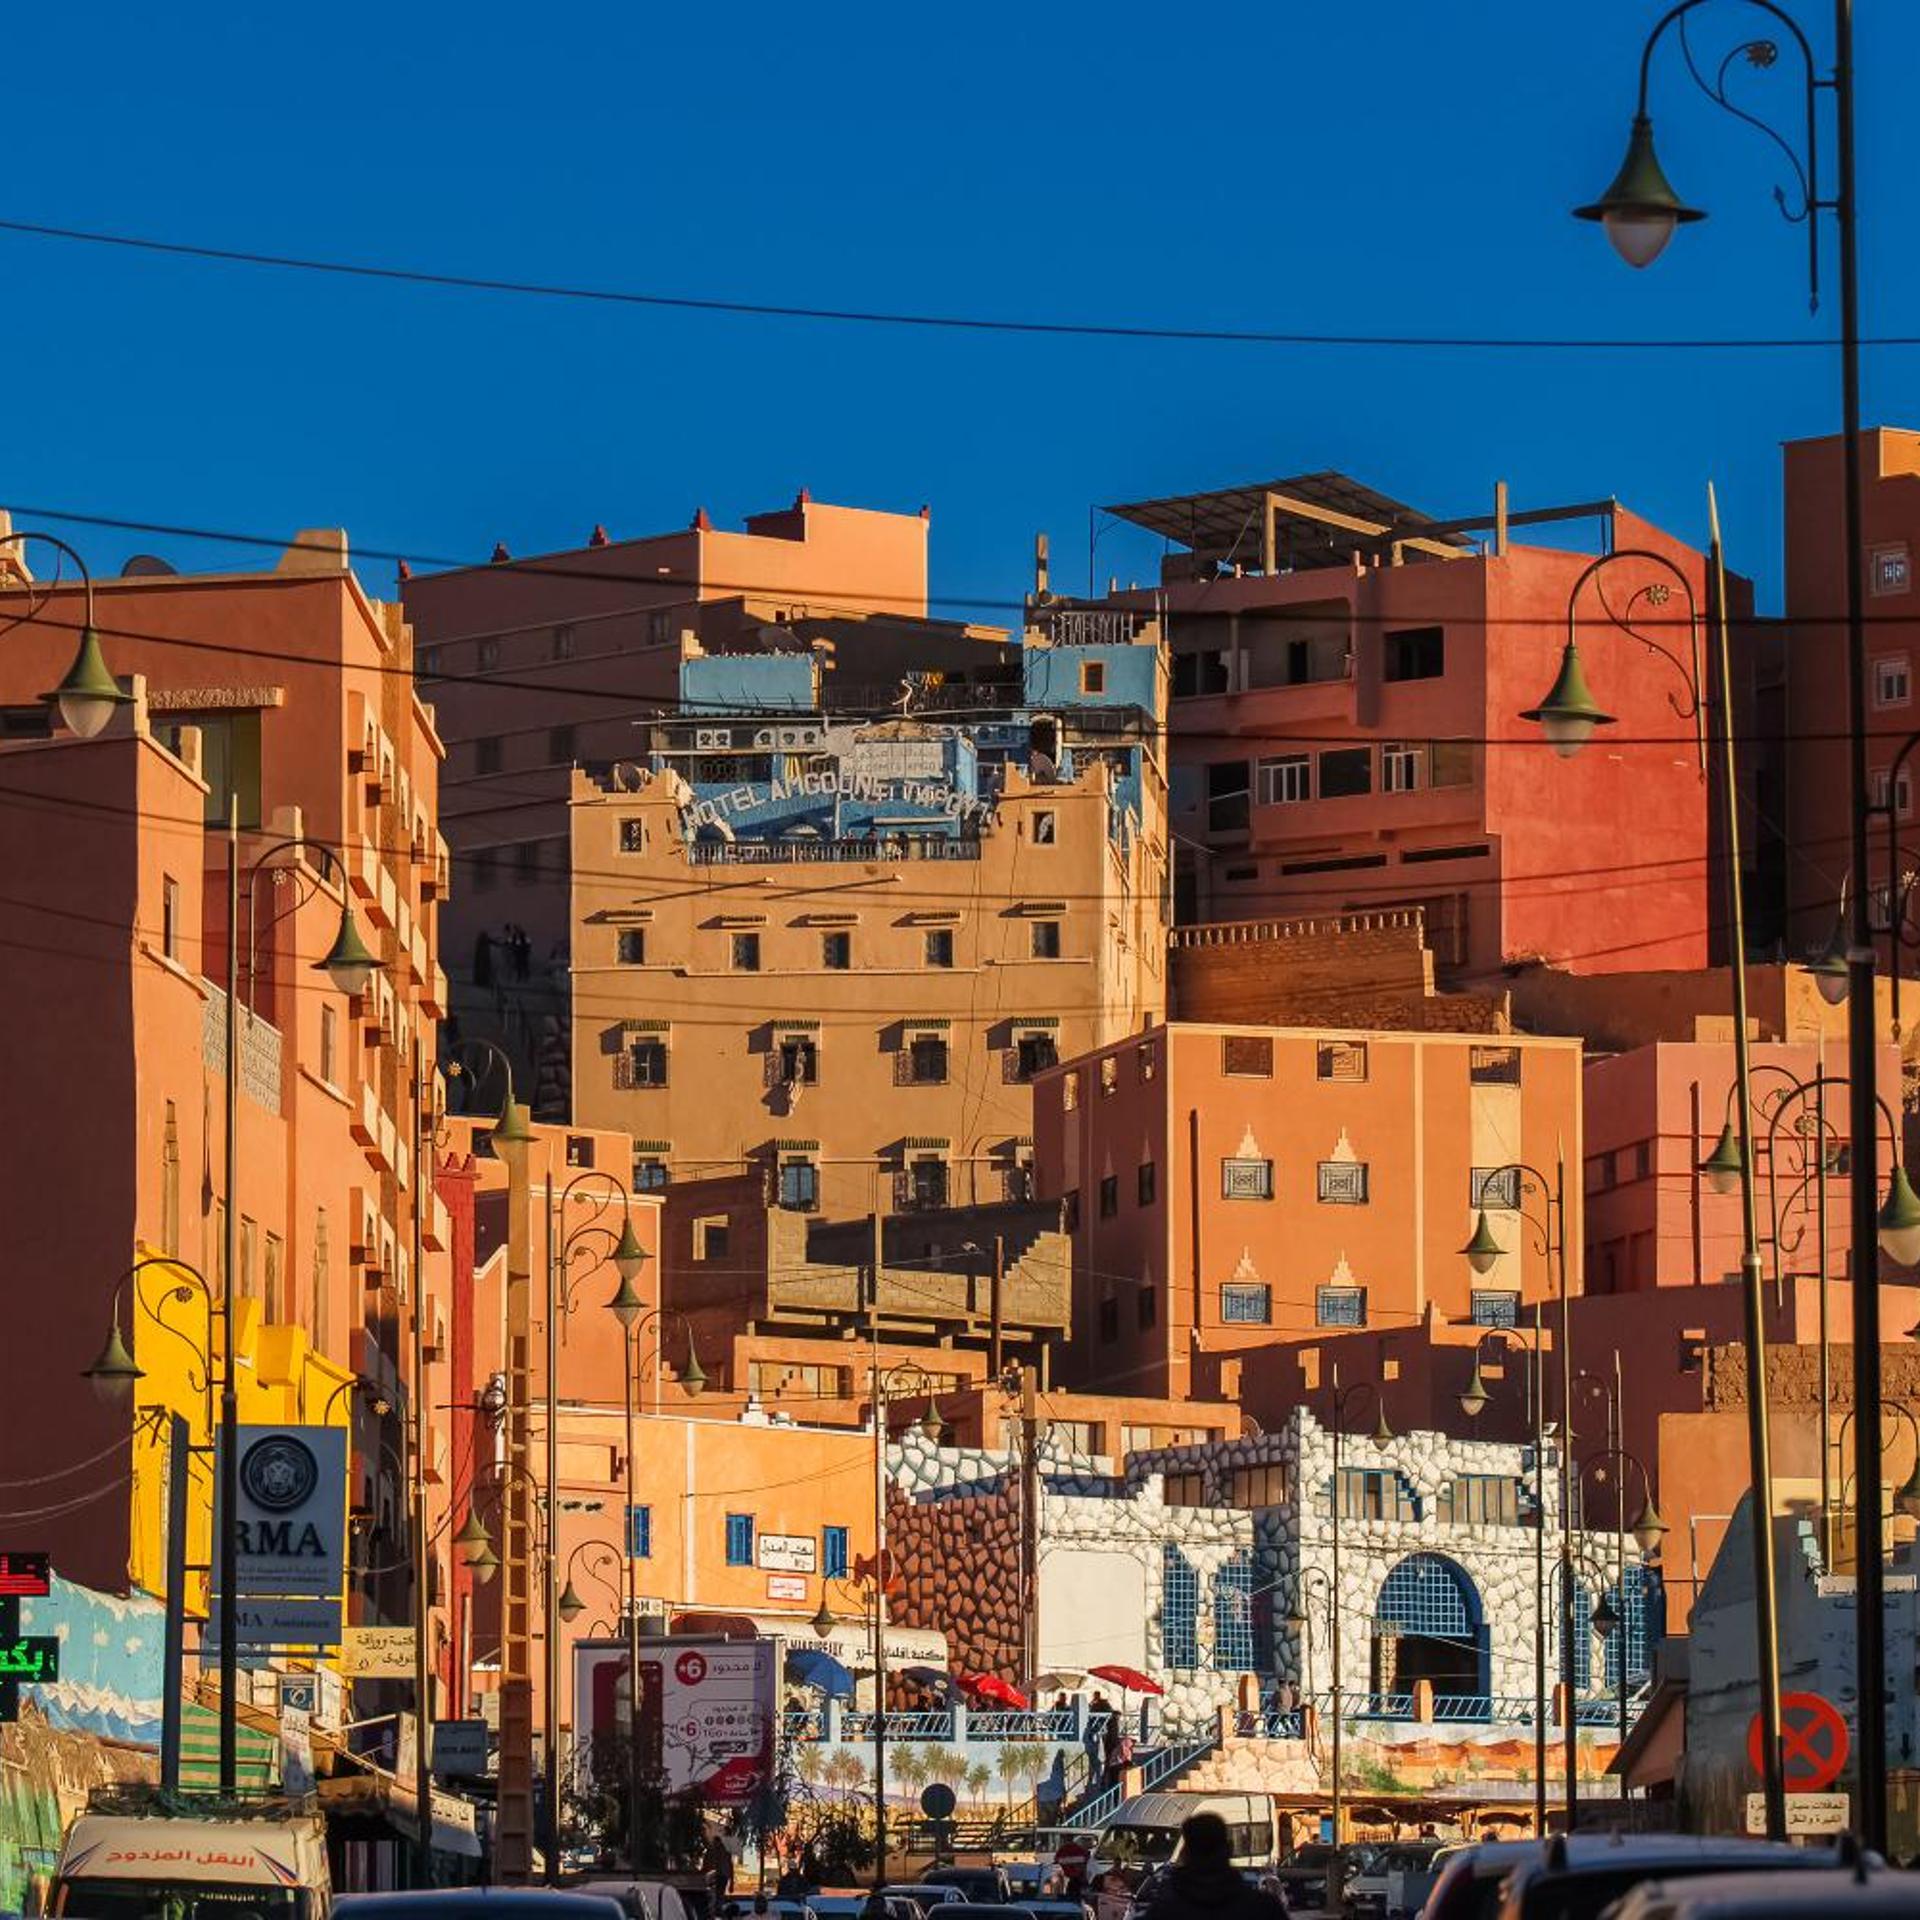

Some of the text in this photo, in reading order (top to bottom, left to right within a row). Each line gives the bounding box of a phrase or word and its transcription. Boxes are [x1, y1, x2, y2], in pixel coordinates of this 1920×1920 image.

[683, 785, 767, 827] HOTEL
[105, 1850, 255, 1868] النقل المزدوج
